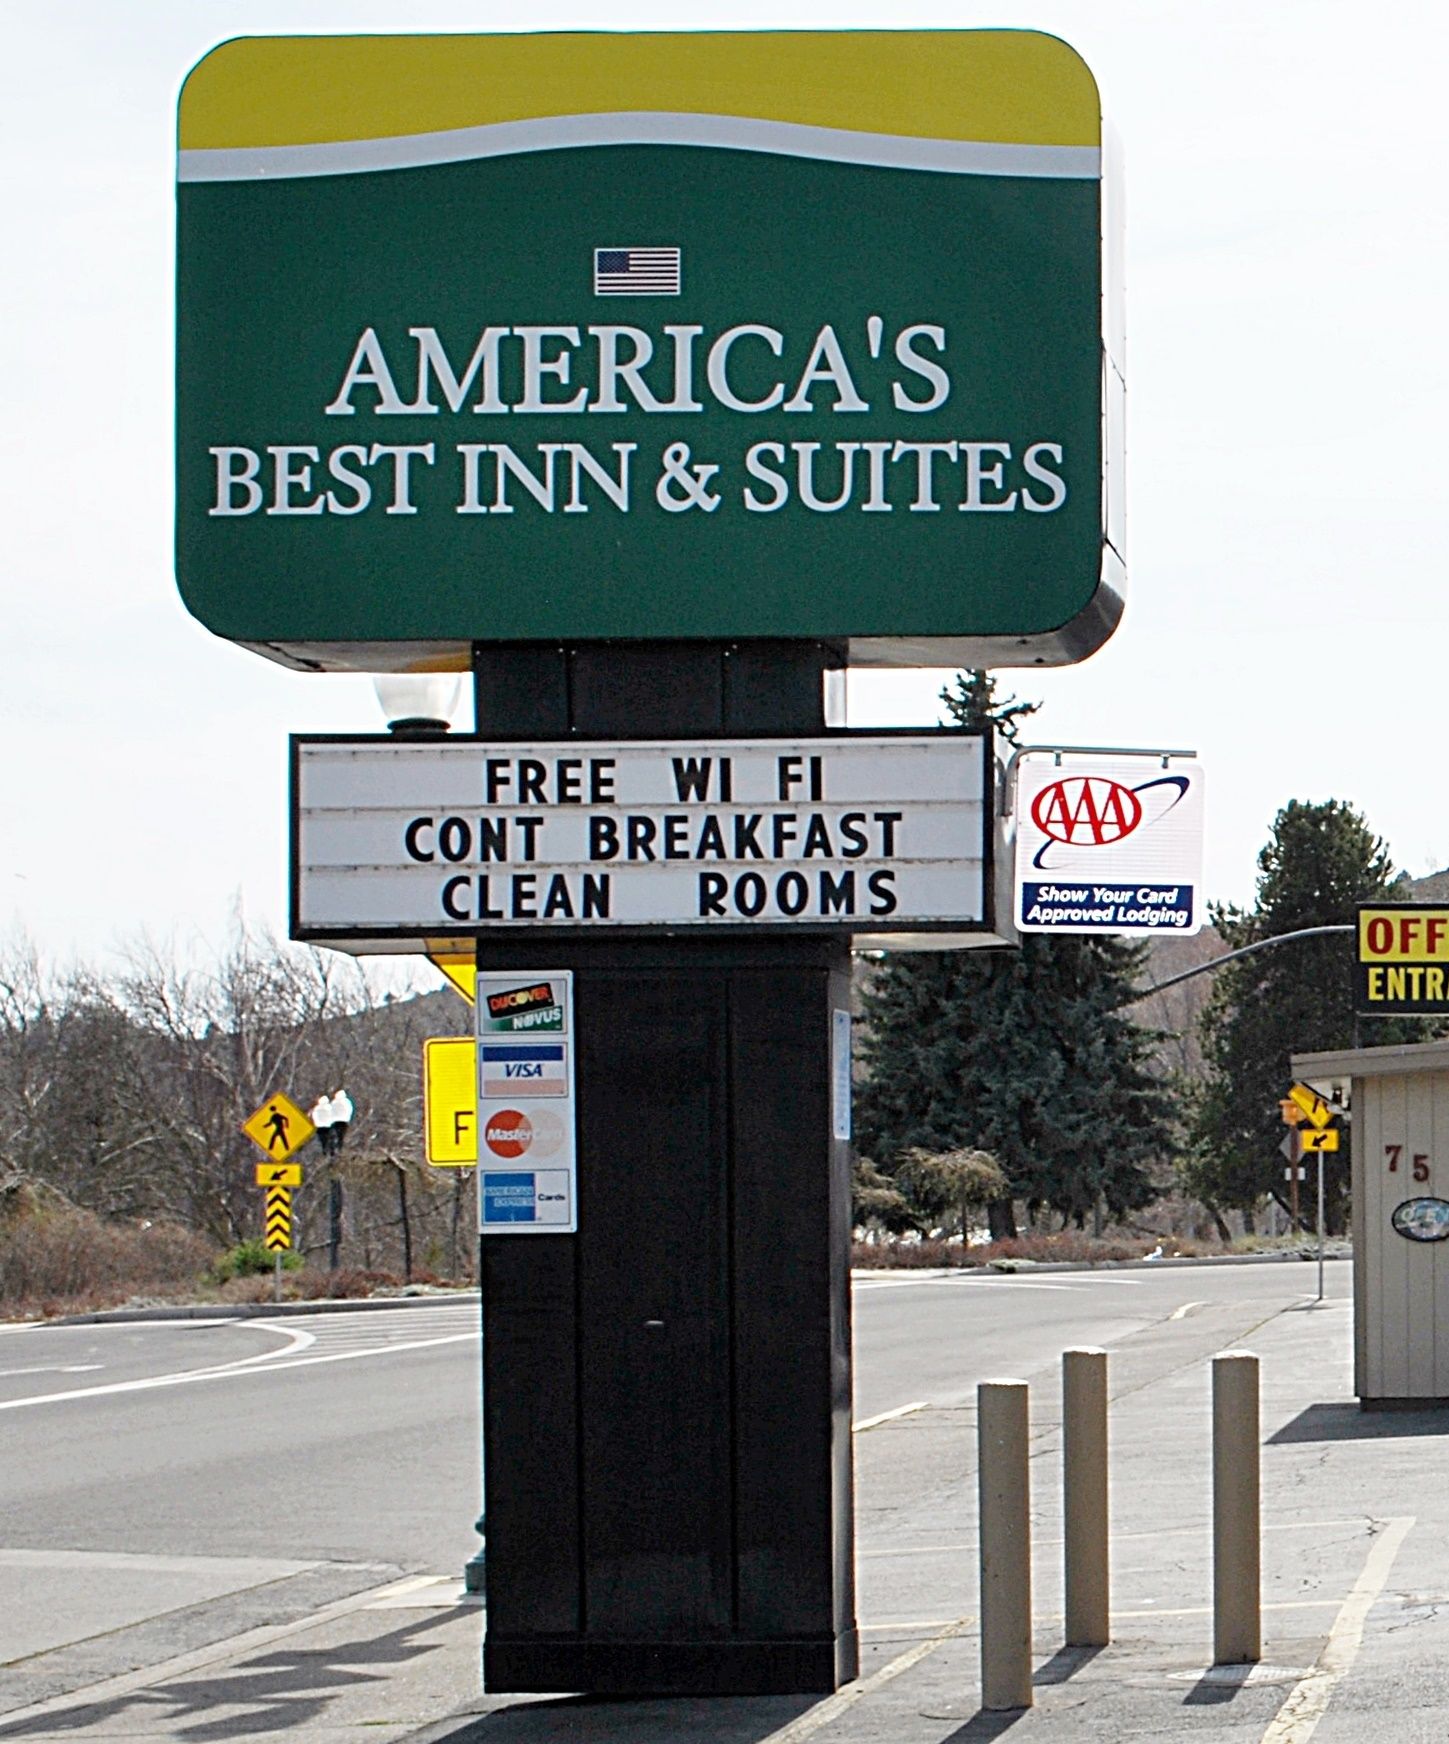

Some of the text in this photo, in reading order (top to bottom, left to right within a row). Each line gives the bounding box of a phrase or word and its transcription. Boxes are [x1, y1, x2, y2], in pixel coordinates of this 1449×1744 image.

[325, 317, 952, 414] AMERICA'S
[208, 442, 1067, 518] BEST INN & SUITES
[486, 756, 822, 803] FREE WI FI
[1045, 778, 1126, 844] AAA
[404, 811, 902, 861] CONT BREAKFAST
[442, 871, 897, 918] CLEAN ROOMS
[1027, 904, 1188, 927] Approved Lodging
[1037, 886, 1179, 905] Show Your Card
[513, 1008, 561, 1029] NOVUS
[505, 1063, 543, 1078] VISA
